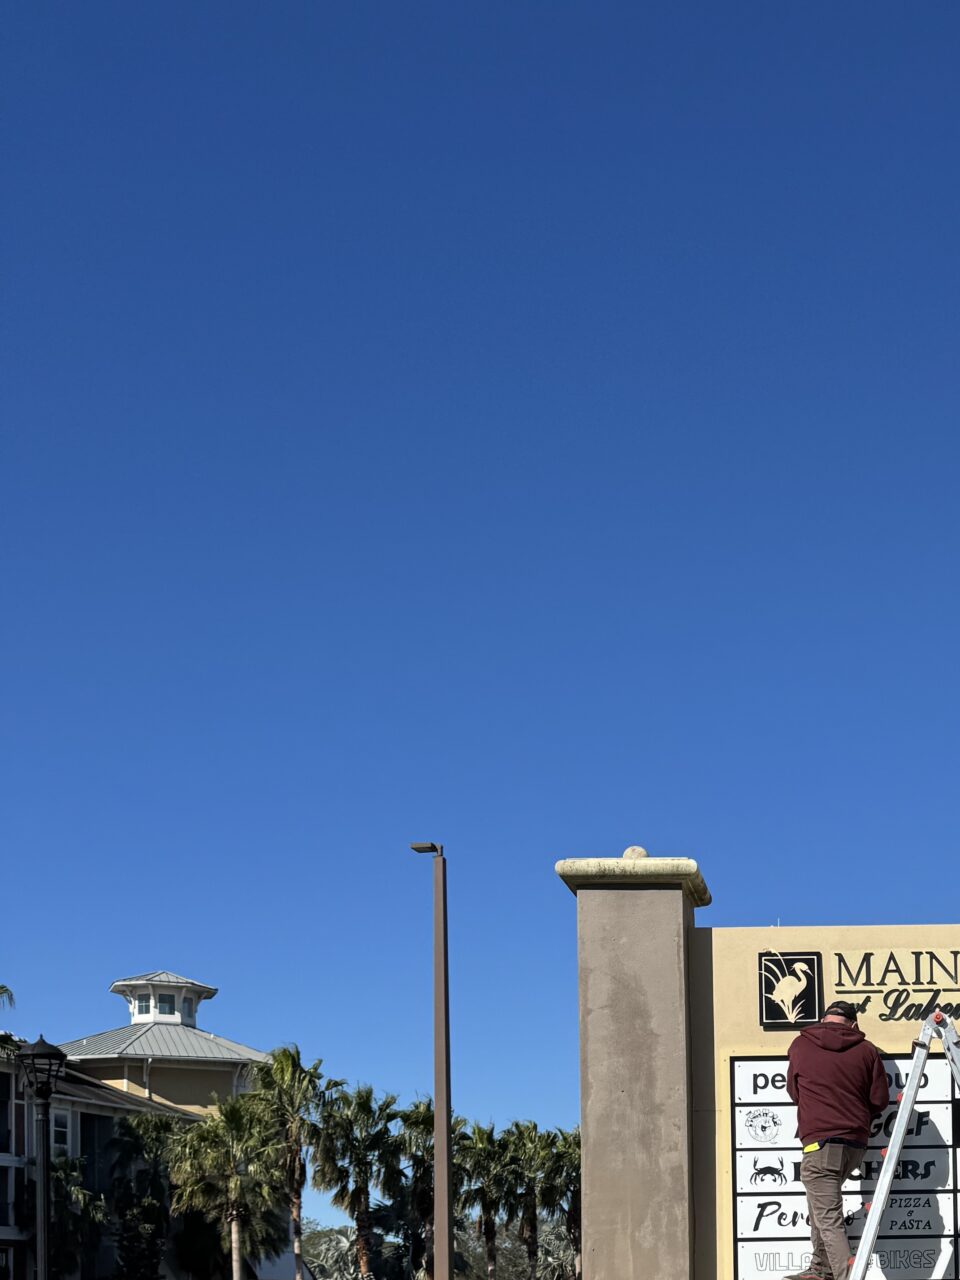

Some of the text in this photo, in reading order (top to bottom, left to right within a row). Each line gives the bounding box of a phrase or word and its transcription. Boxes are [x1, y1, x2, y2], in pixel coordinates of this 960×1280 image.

[834, 950, 960, 987] MAIN
[889, 1197, 932, 1208] PIZZA
[889, 1219, 932, 1230] PASTA
[875, 1249, 936, 1269] BIKES
